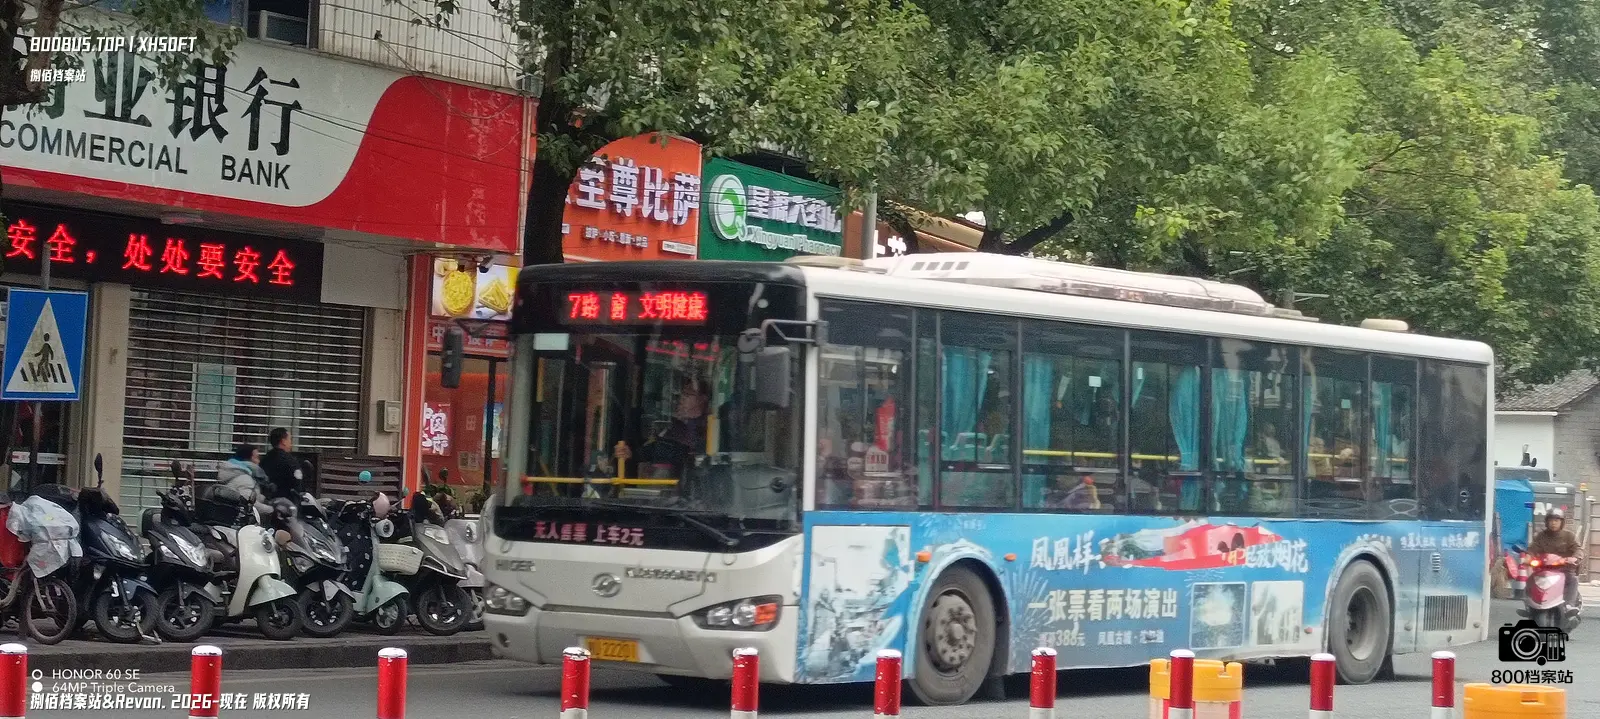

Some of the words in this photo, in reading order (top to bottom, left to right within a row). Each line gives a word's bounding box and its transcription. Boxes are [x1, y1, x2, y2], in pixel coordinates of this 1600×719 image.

[8, 46, 302, 156] 业银行
[0, 120, 188, 174] COMMERCIAL
[221, 154, 291, 190] BANK
[568, 291, 600, 320] 7路
[593, 523, 645, 547] 上车2元
[1027, 588, 1178, 621] 一张票看两场演出
